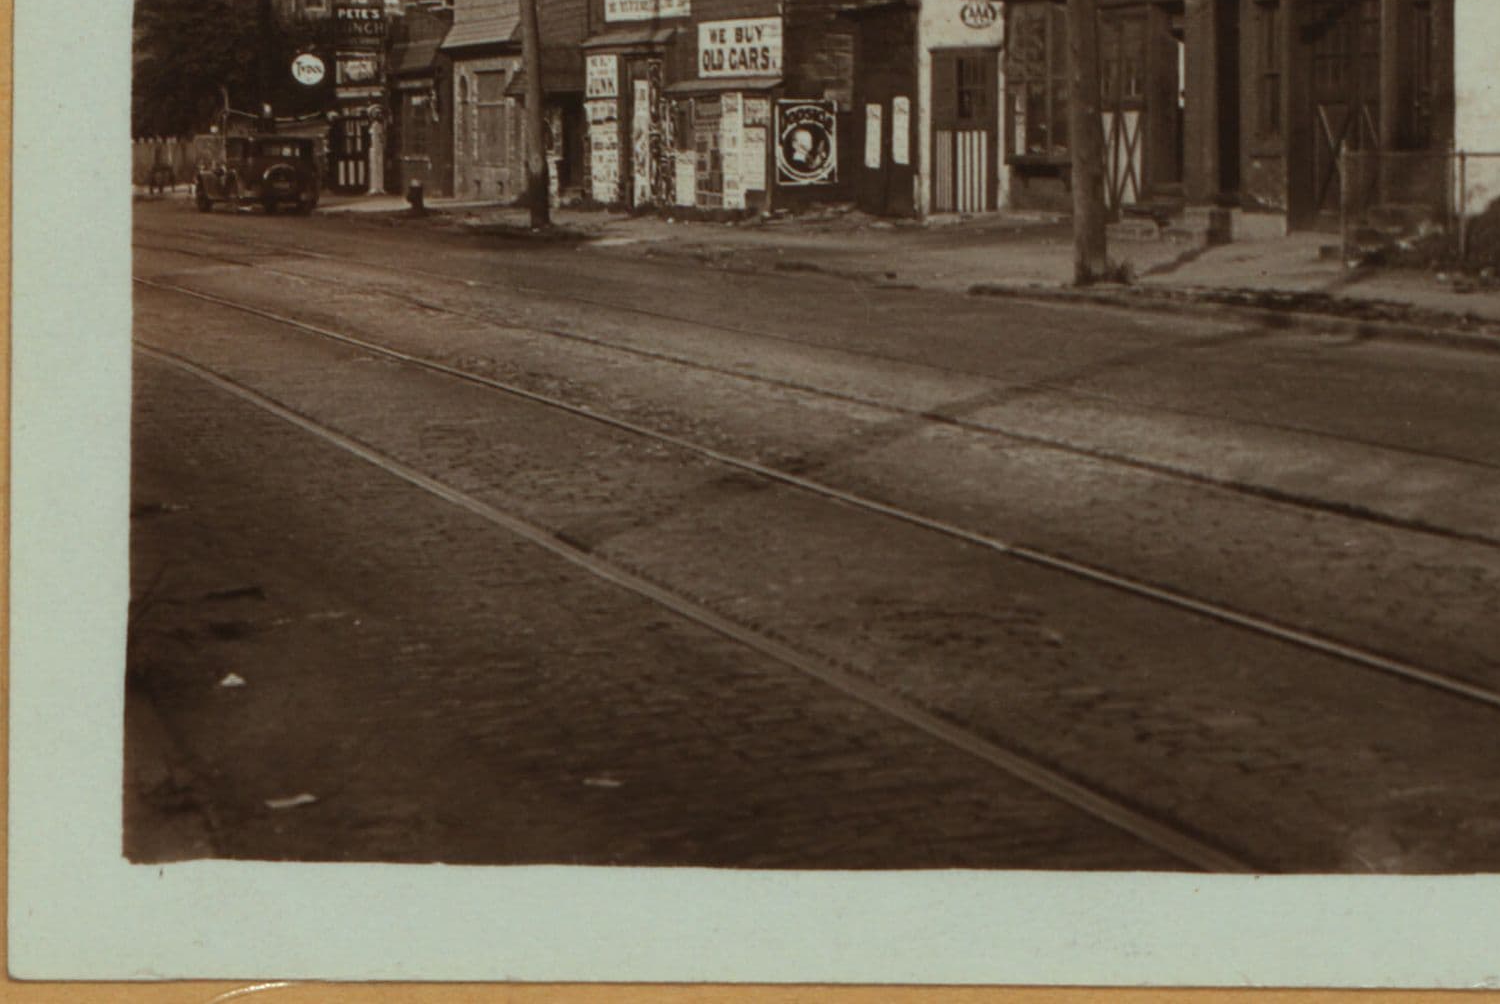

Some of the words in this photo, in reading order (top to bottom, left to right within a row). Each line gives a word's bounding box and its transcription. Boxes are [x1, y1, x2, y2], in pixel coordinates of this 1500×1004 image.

[337, 8, 380, 20] PETE'S
[708, 27, 727, 45] WE
[735, 24, 765, 44] BUY
[702, 48, 725, 72] OLD
